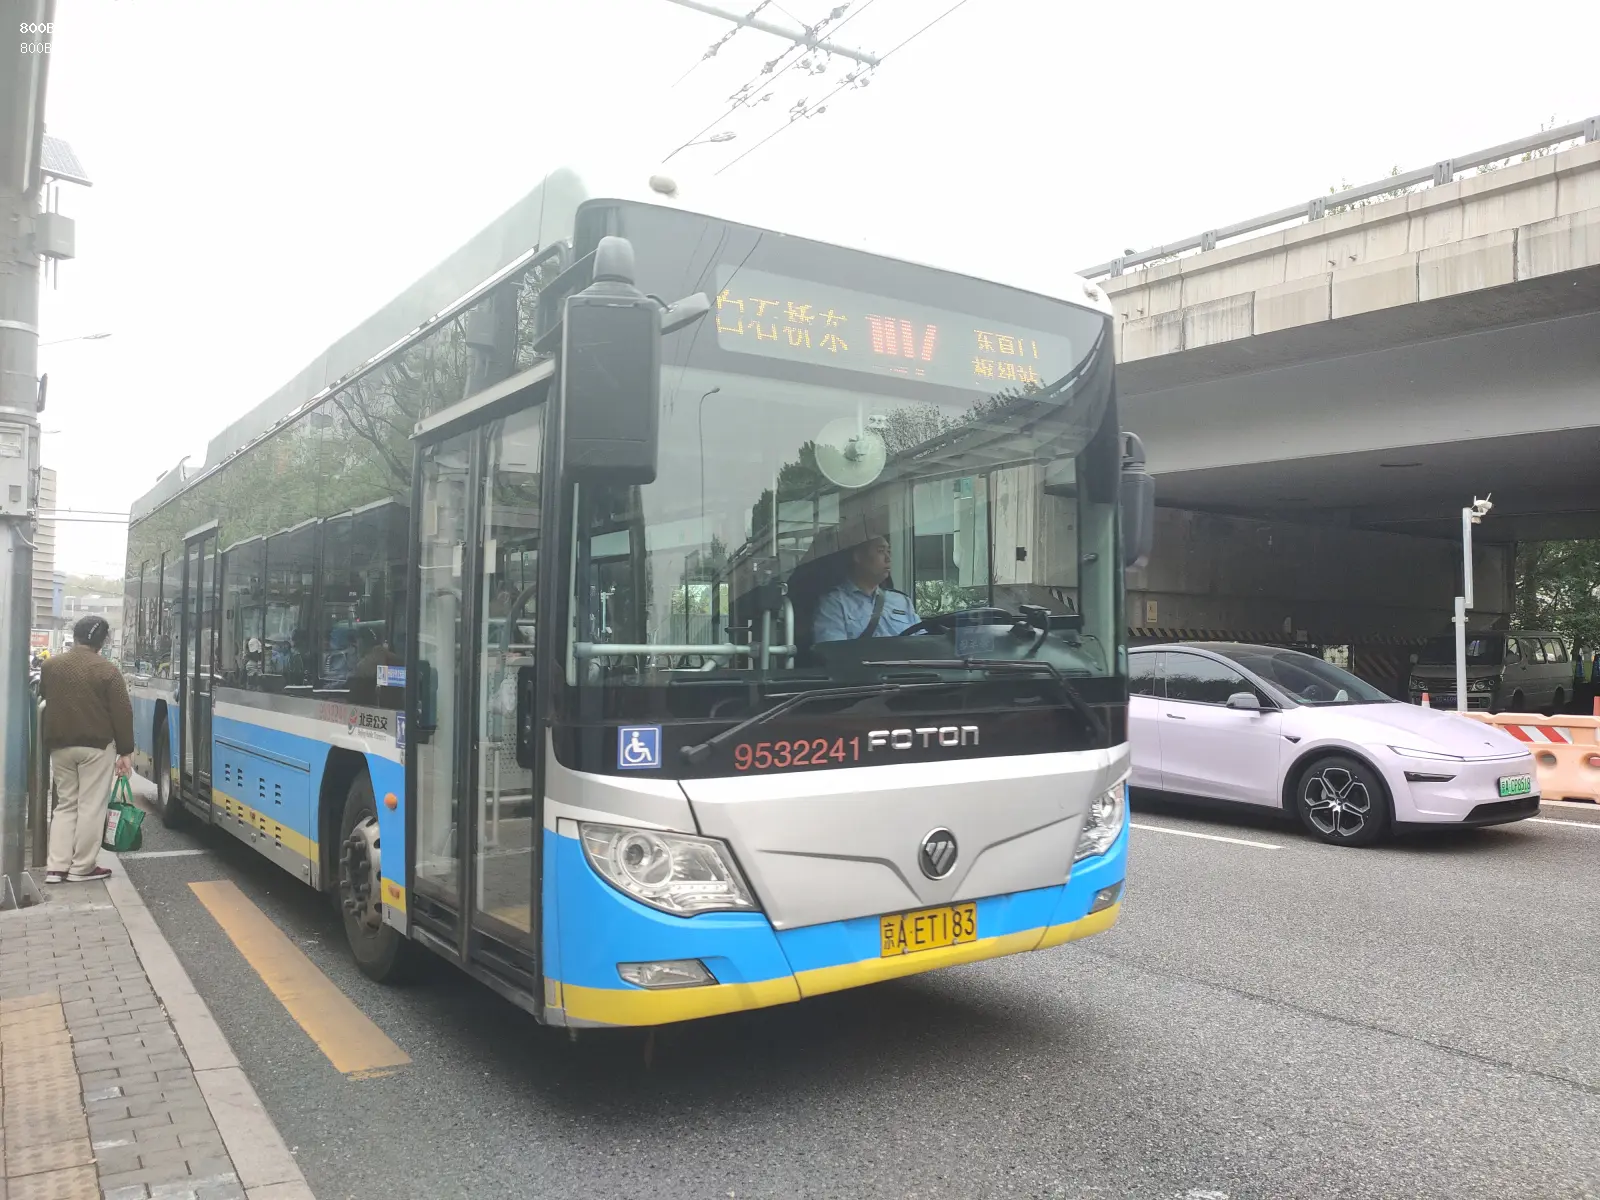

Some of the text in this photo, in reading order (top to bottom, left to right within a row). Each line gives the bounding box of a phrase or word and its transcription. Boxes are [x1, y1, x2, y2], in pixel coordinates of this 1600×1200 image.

[358, 712, 388, 731] 北京公交
[867, 725, 980, 752] FOTON
[733, 736, 861, 771] 9532241
